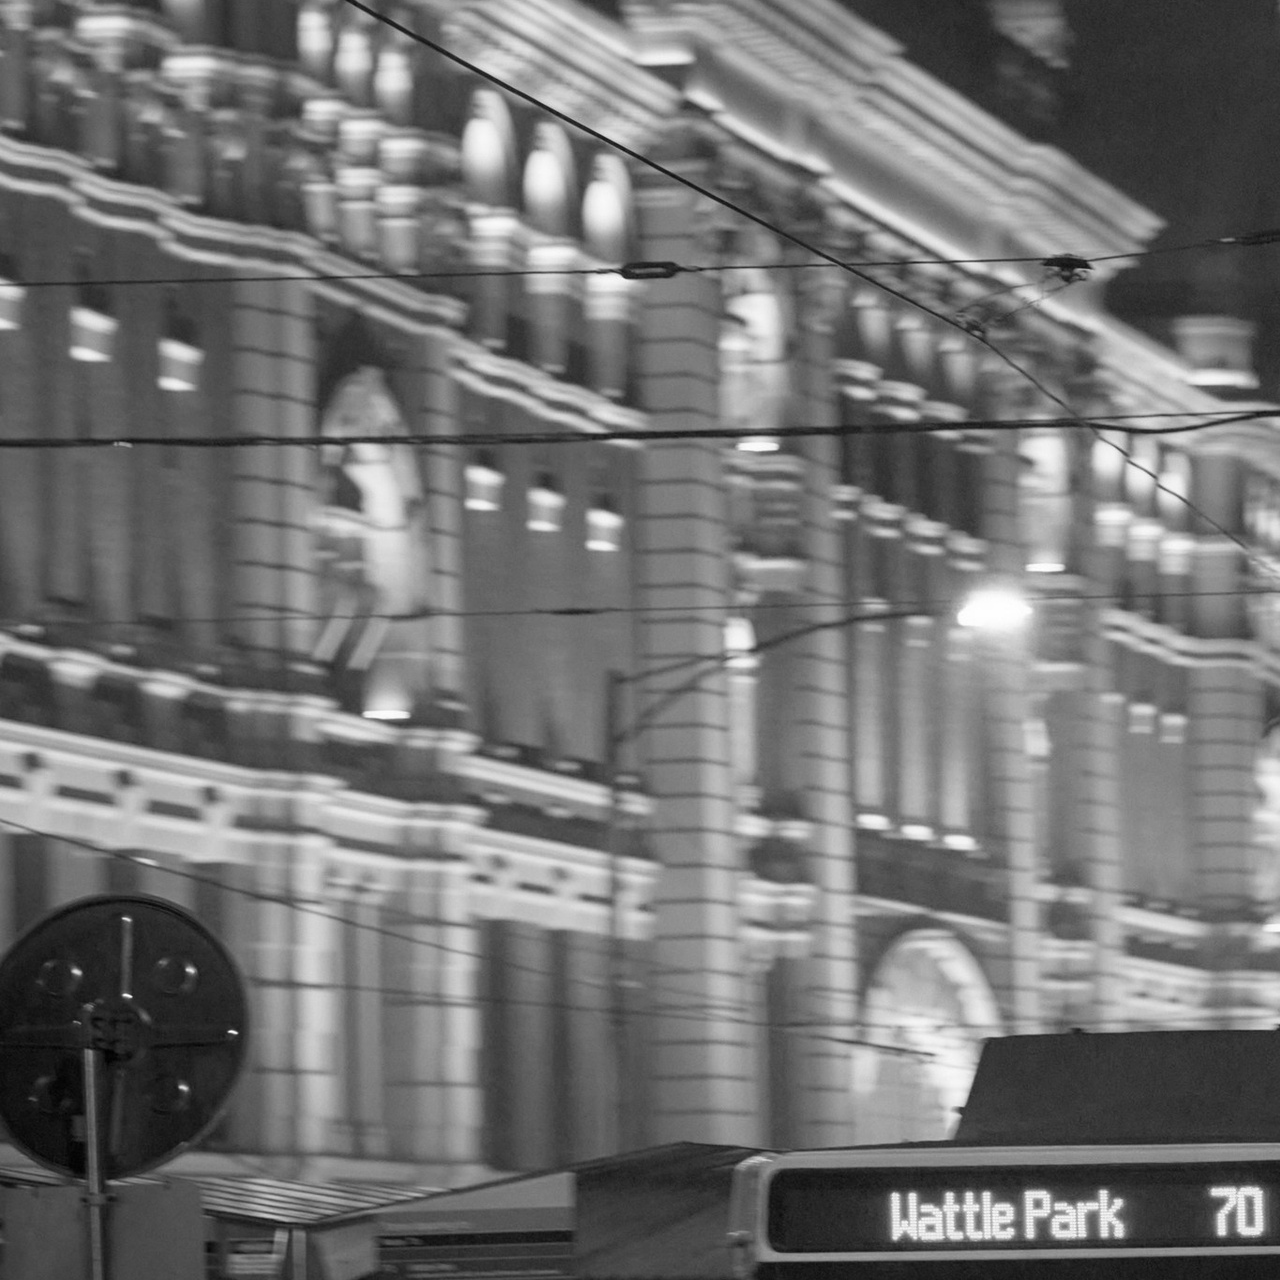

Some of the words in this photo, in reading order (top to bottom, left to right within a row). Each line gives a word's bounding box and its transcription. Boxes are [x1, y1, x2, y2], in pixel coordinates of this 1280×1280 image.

[889, 1190, 1017, 1242] Wattle
[1023, 1188, 1126, 1240] Park
[1207, 1185, 1265, 1238] 70
